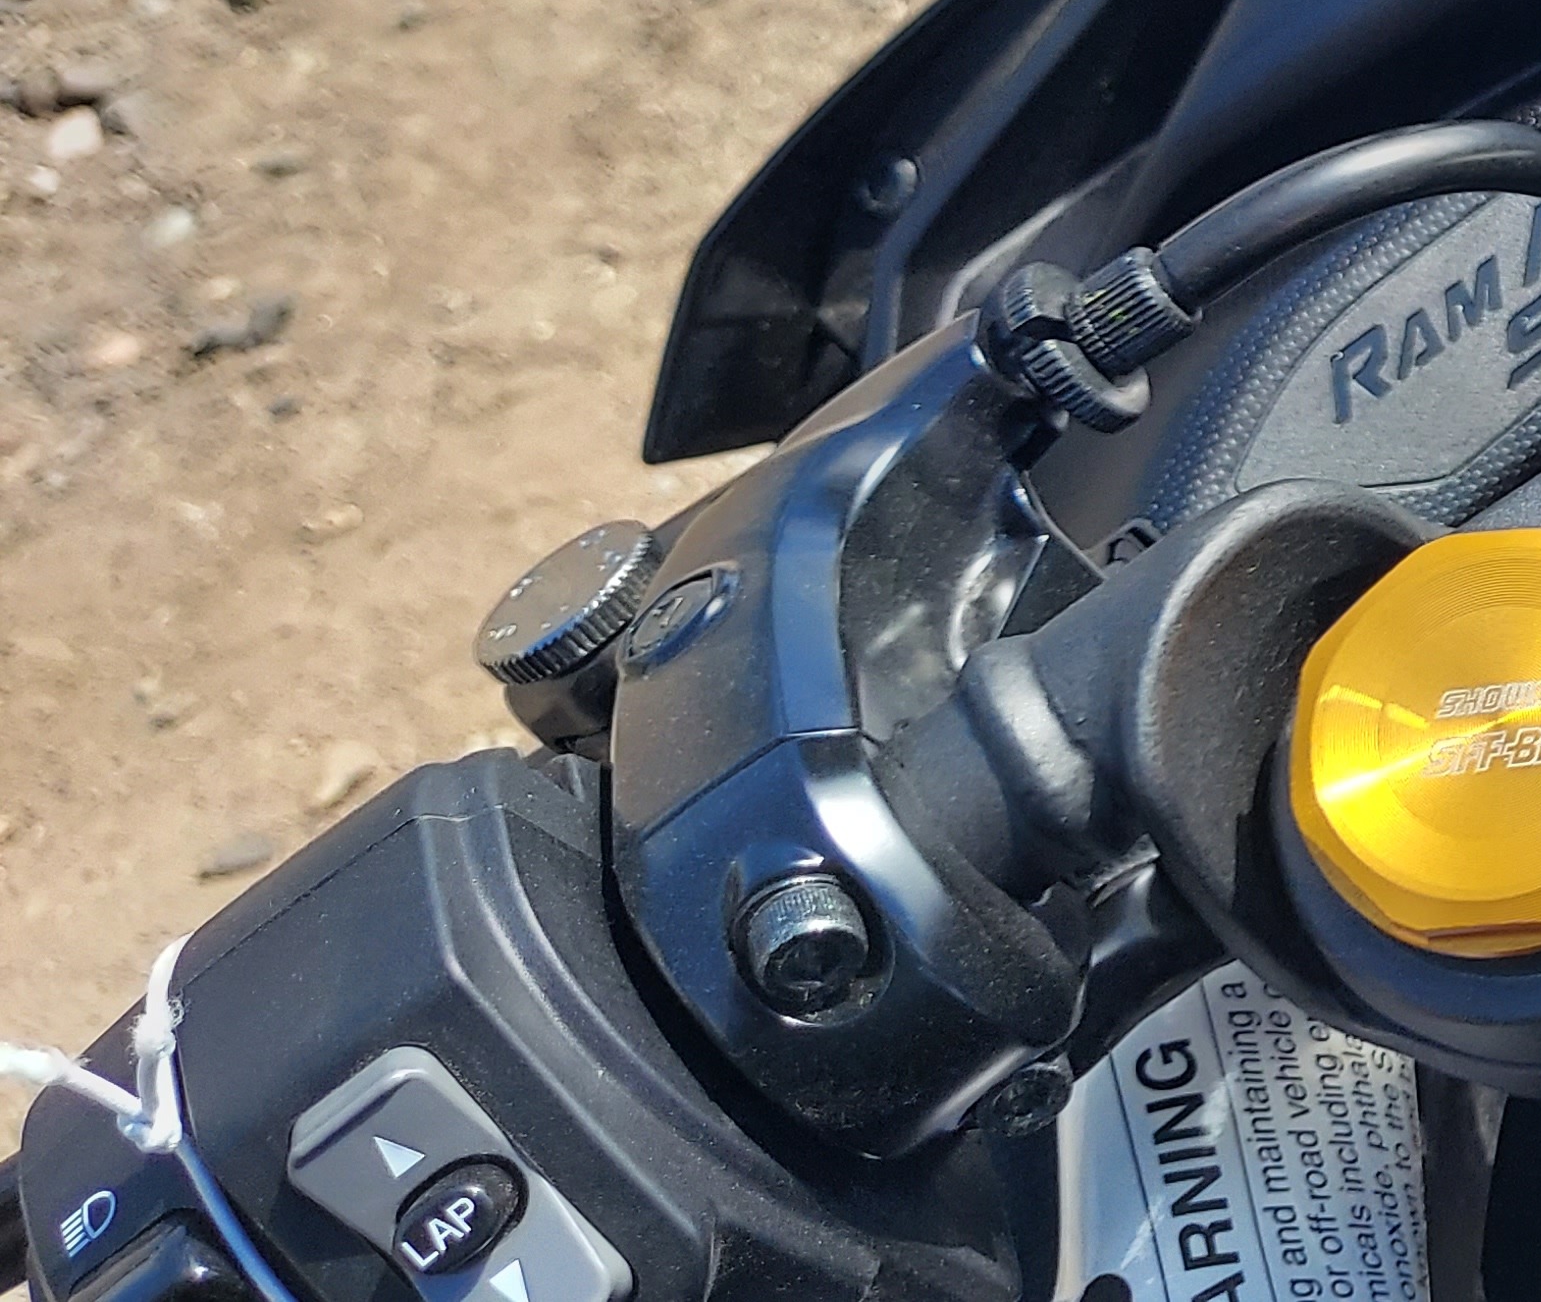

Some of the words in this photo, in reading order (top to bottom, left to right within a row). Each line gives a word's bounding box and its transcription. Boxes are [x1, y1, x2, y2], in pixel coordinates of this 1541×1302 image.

[1330, 254, 1503, 426] RAM
[1220, 981, 1248, 999] a
[1227, 1009, 1291, 1194] maintaining
[1263, 1009, 1311, 1118] vehicle
[1342, 1034, 1389, 1151] phthala
[1313, 1053, 1365, 1193] including
[401, 1196, 477, 1271] LAP
[1263, 1205, 1309, 1267] and
[1286, 1129, 1345, 1255] off-road
[1325, 1265, 1353, 1300] or
